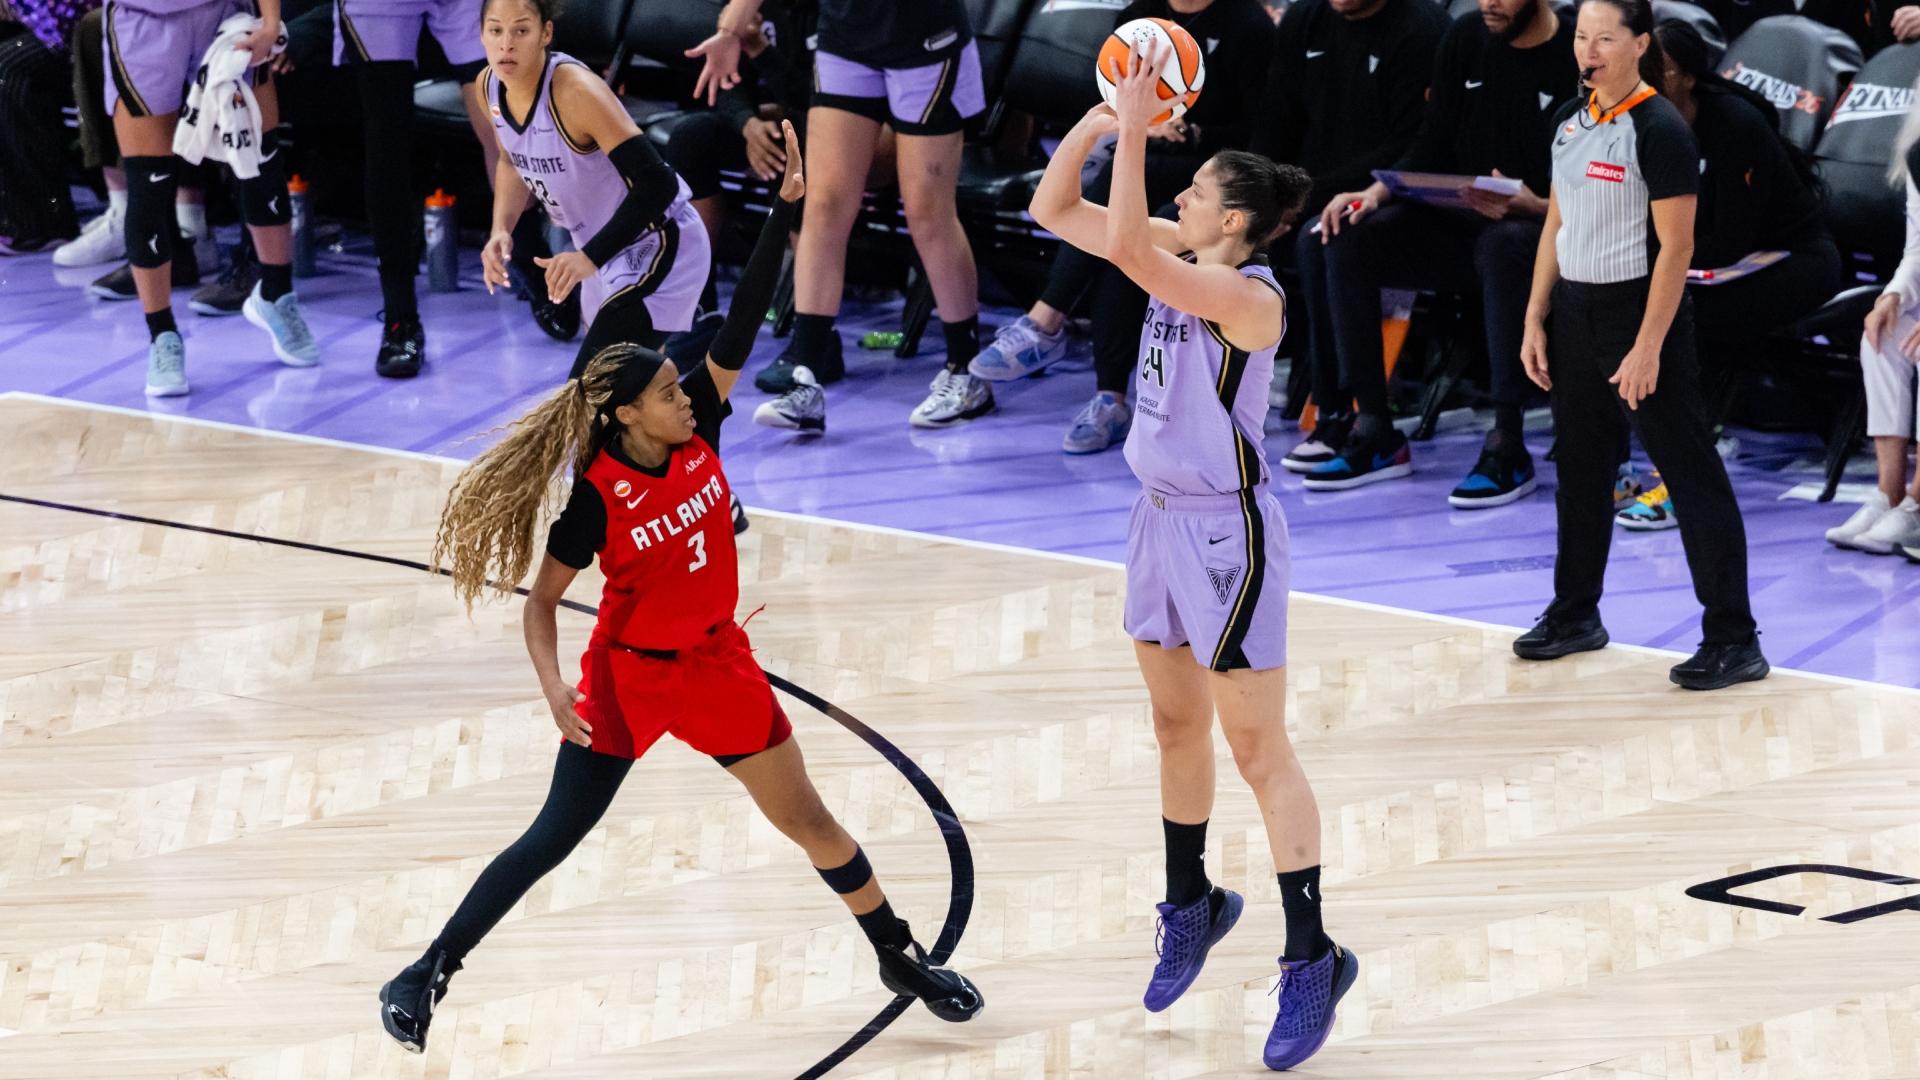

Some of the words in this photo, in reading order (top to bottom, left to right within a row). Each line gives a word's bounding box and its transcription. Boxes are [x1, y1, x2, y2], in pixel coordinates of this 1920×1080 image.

[530, 156, 567, 174] STATE
[1587, 163, 1624, 180] Emirates
[1137, 404, 1172, 423] PERMATE
[684, 450, 708, 476] Albert
[630, 474, 723, 551] ATLANTA
[687, 529, 708, 573] 3
